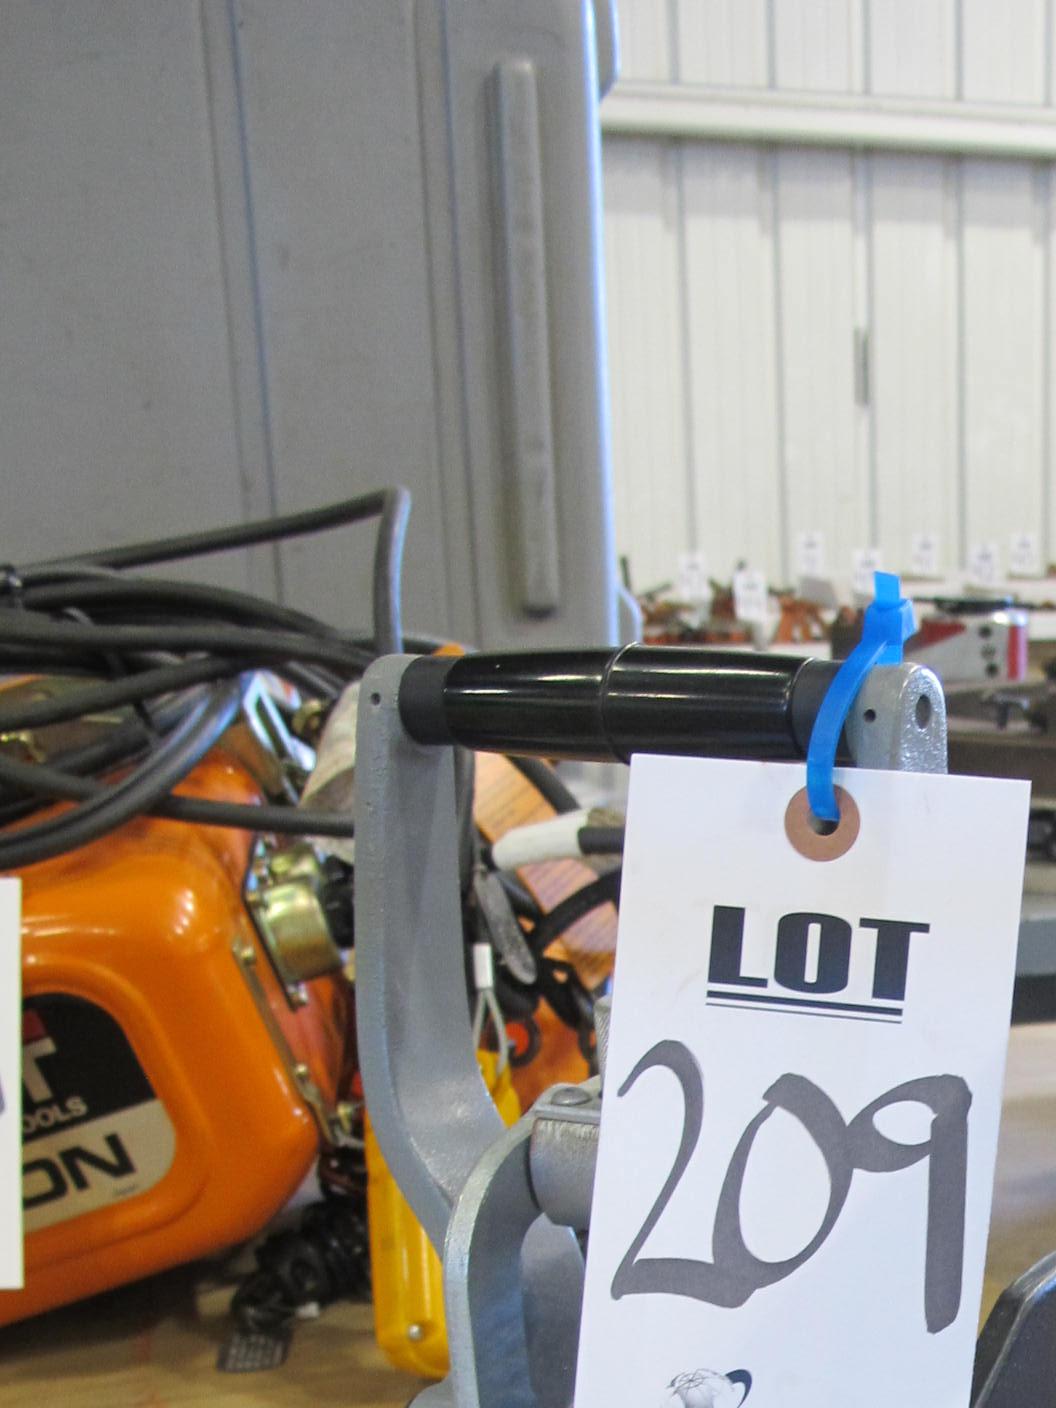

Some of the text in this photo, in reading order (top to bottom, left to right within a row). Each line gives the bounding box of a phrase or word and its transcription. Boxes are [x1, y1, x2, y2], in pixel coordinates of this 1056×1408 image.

[707, 905, 930, 1001] LOT
[22, 1096, 88, 1133] OOLS
[22, 1133, 136, 1211] ON
[611, 1039, 972, 1334] 209
